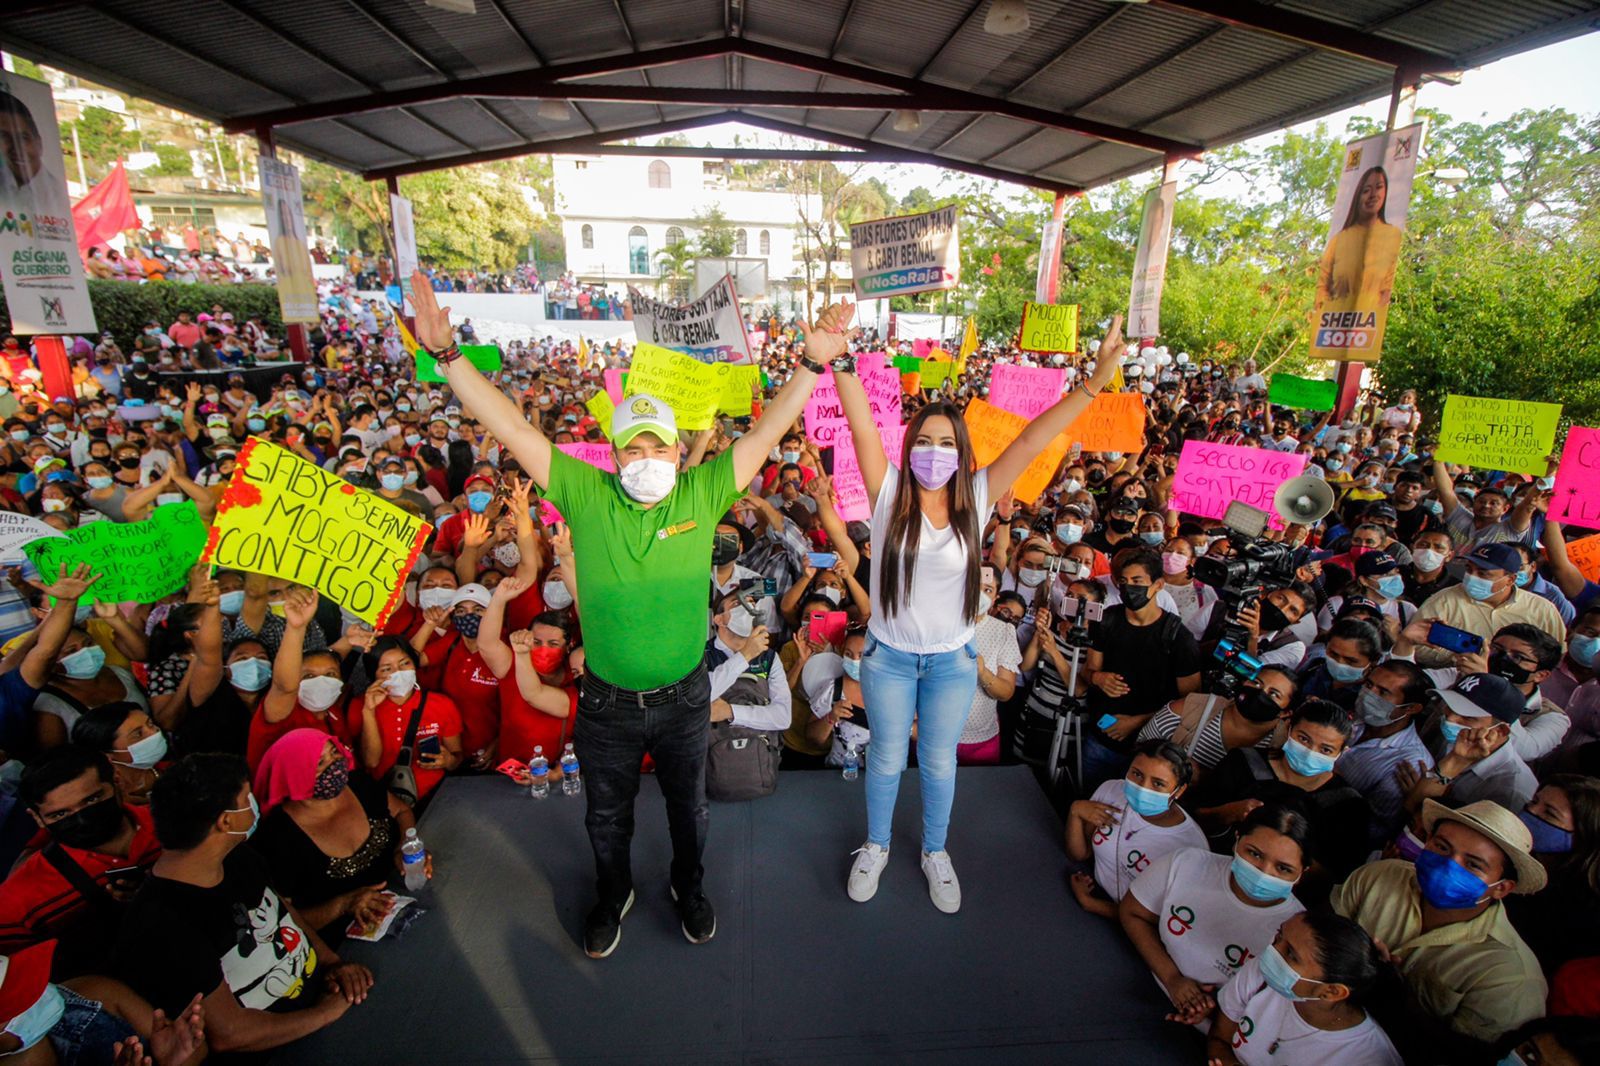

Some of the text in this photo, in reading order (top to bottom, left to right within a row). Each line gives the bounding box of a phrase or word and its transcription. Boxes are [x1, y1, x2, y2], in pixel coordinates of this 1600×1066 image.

[851, 209, 954, 249] ELIAS FLORES CON TAJA
[13, 246, 68, 263] ASÍ GANA
[866, 240, 936, 272] & GABY BERNAL
[12, 264, 72, 276] GUERRERO
[863, 268, 940, 290] #NoSeRaja
[709, 283, 732, 313] TAJA
[1045, 321, 1064, 334] CON
[1320, 311, 1377, 328] SHEILA
[681, 317, 720, 346] BERNAL
[1322, 331, 1368, 347] SOTO
[1032, 331, 1073, 351] GABY
[669, 355, 700, 372] GABY
[651, 366, 681, 381] GRUPO
[1003, 399, 1047, 414] GABY
[1089, 416, 1115, 432] CON
[1486, 423, 1535, 439] TAJA
[1455, 431, 1489, 447] GABY
[1494, 434, 1543, 451] BERNAL
[1261, 459, 1291, 480] 168
[1466, 453, 1530, 469] ANTONIO
[243, 441, 341, 506] GABY
[262, 494, 408, 593] MOGOTES
[216, 527, 374, 613] CONTIGO
[1458, 675, 1481, 692] NY
